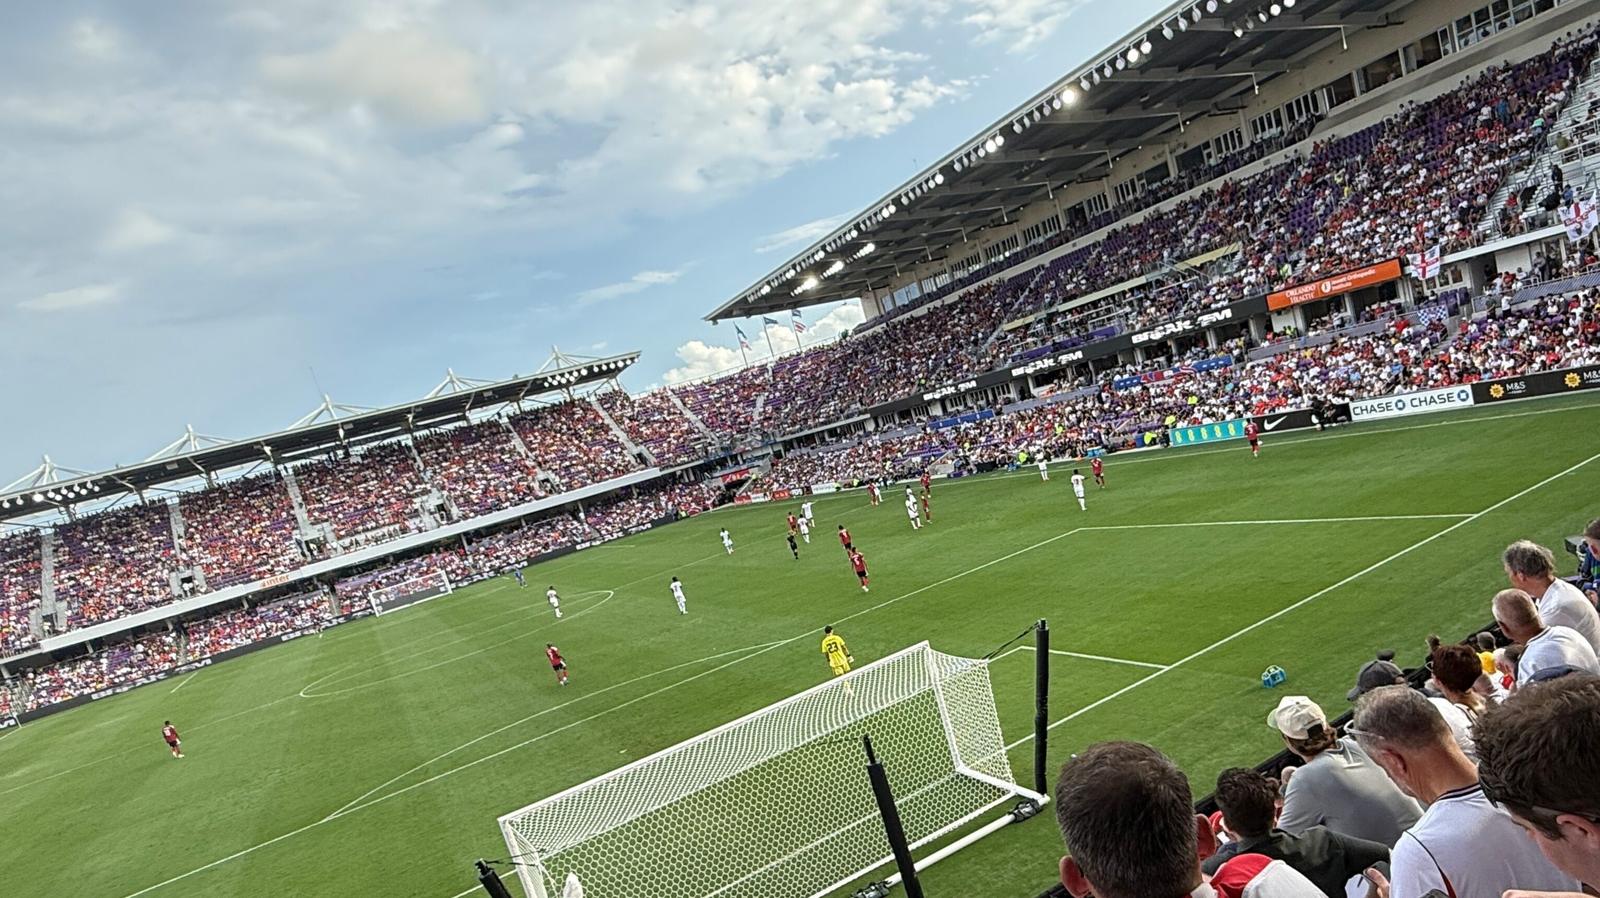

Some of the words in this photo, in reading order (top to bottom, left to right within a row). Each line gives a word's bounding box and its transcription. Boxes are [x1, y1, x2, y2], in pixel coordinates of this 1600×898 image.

[1285, 284, 1316, 298] ORLANDO
[1506, 381, 1526, 391] M&S
[1352, 401, 1394, 416] CHASE
[1410, 392, 1455, 409] CHASE
[826, 641, 839, 654] 23
